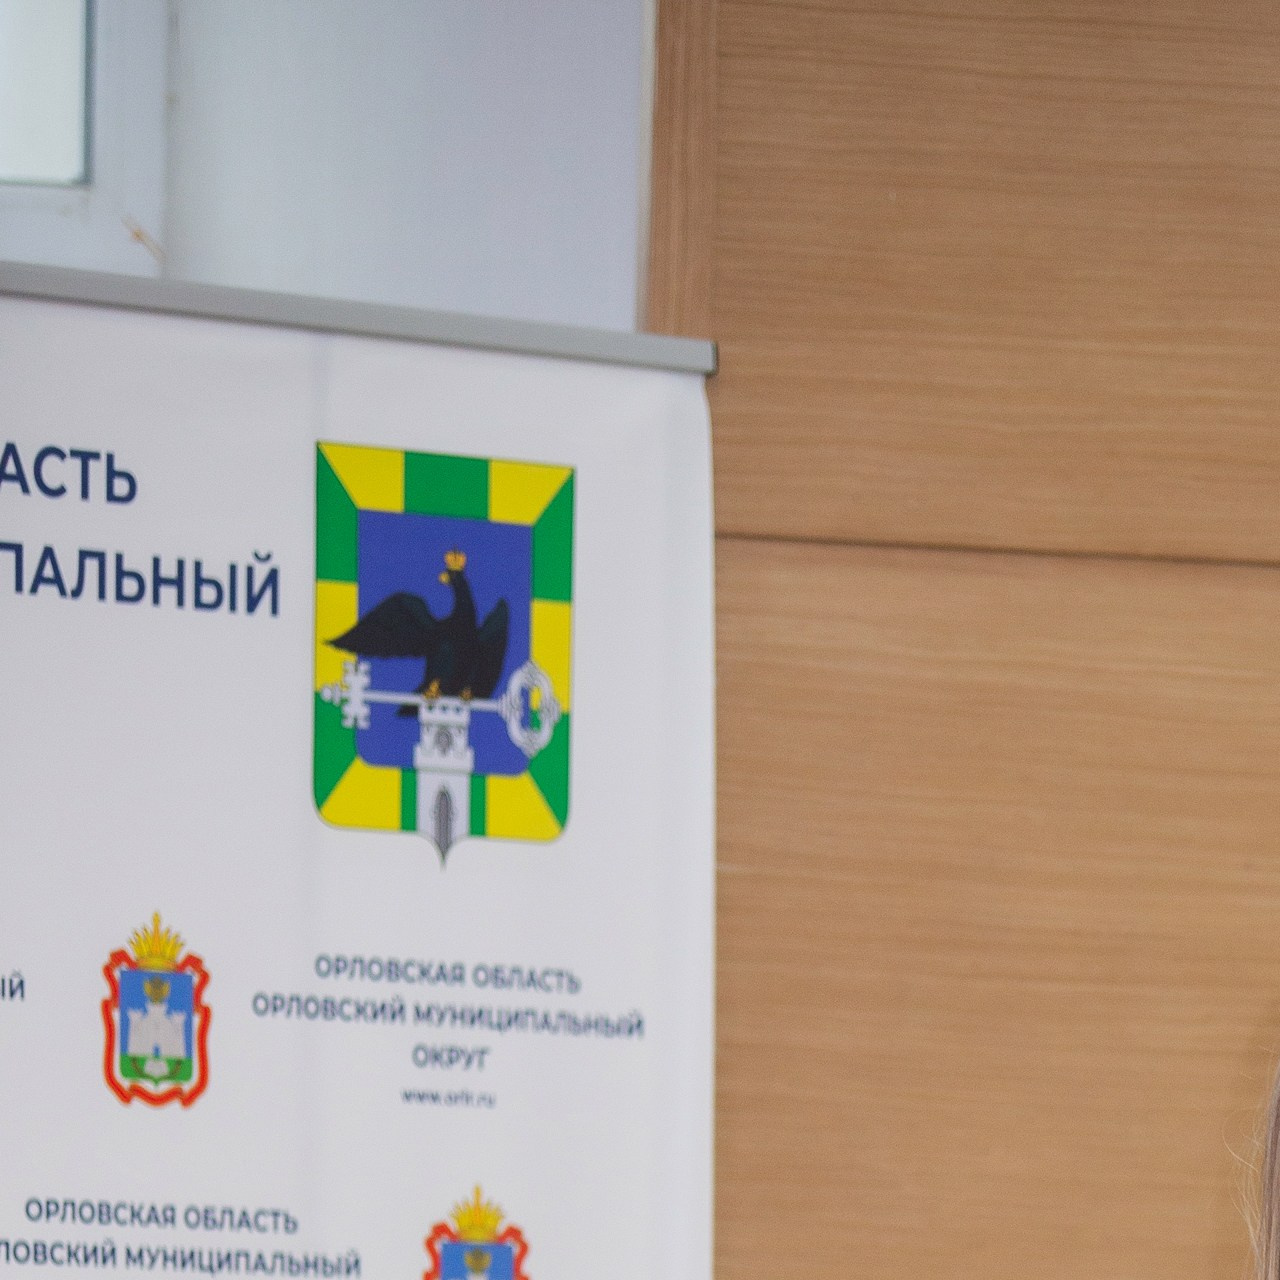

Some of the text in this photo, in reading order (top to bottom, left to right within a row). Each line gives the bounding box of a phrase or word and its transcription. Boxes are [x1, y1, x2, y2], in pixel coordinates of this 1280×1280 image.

[314, 953, 582, 995] ОРЛОВСКАЯ ОБЛАСТЬ
[251, 991, 645, 1039] ОРЛОВСКИЙ МУНИЦИПАЛЬНЫЙ
[412, 1043, 490, 1070] ОКРУГ
[24, 1196, 299, 1235] ОРЛОВСКАЯ ОБЛАСТЬ
[125, 1245, 362, 1279] МУНИЦИПАЛЬНЫЙ
